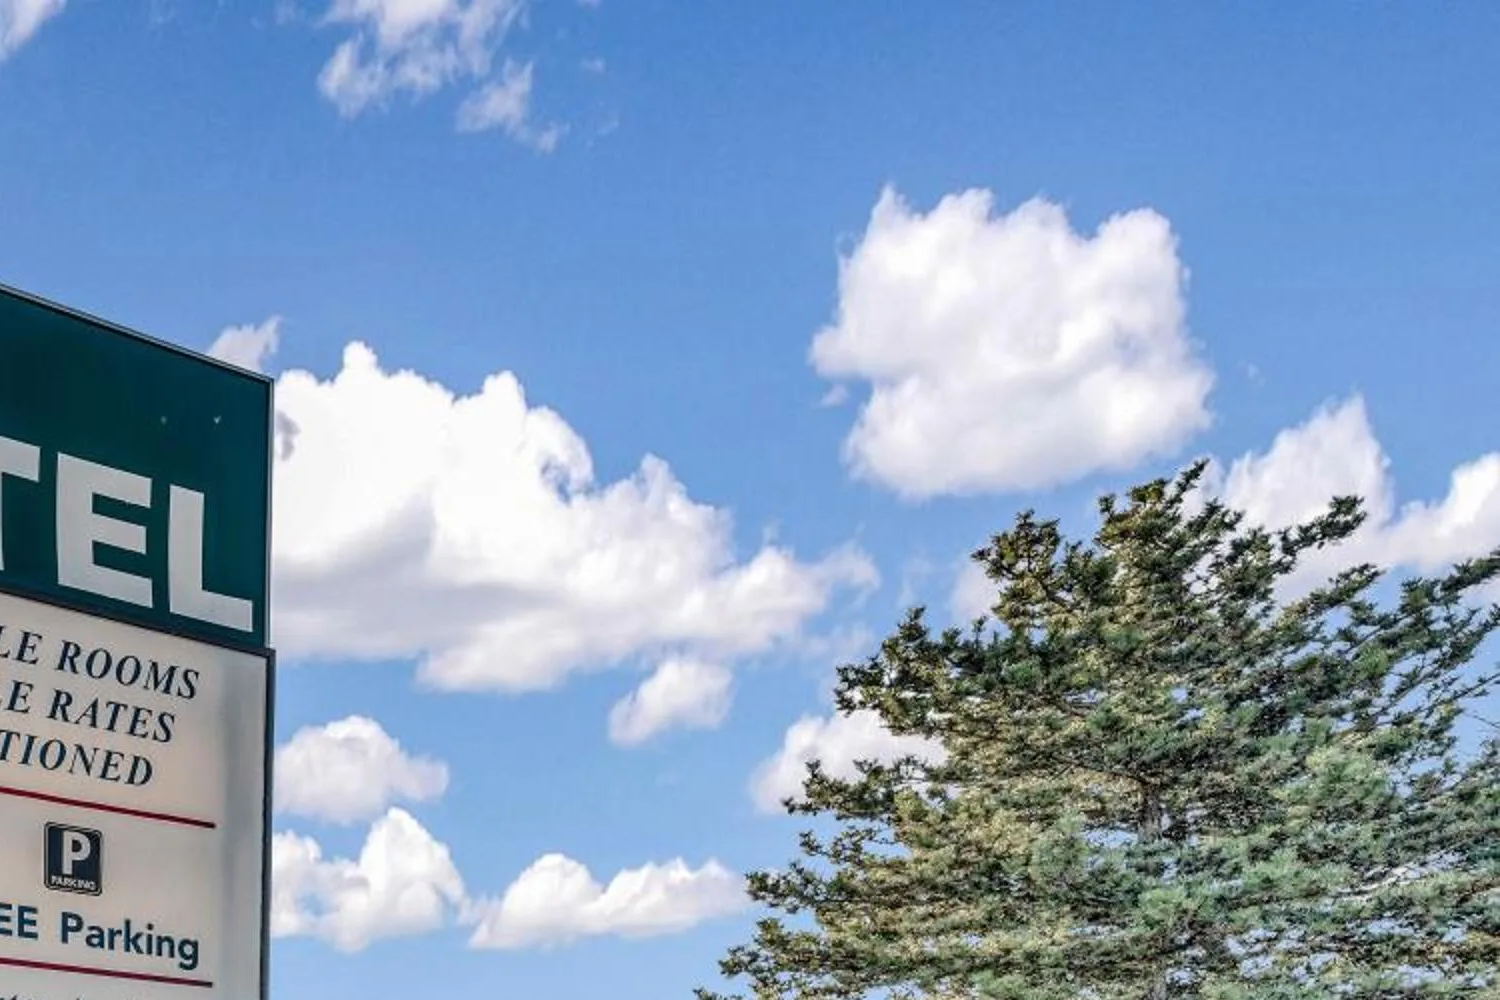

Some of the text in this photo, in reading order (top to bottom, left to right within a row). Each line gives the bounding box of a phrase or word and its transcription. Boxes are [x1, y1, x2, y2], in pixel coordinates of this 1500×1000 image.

[56, 639, 200, 700] ROOMS
[49, 689, 175, 744] RATES
[62, 830, 91, 874] P
[51, 875, 97, 890] PARKING
[61, 911, 199, 971] Parking
